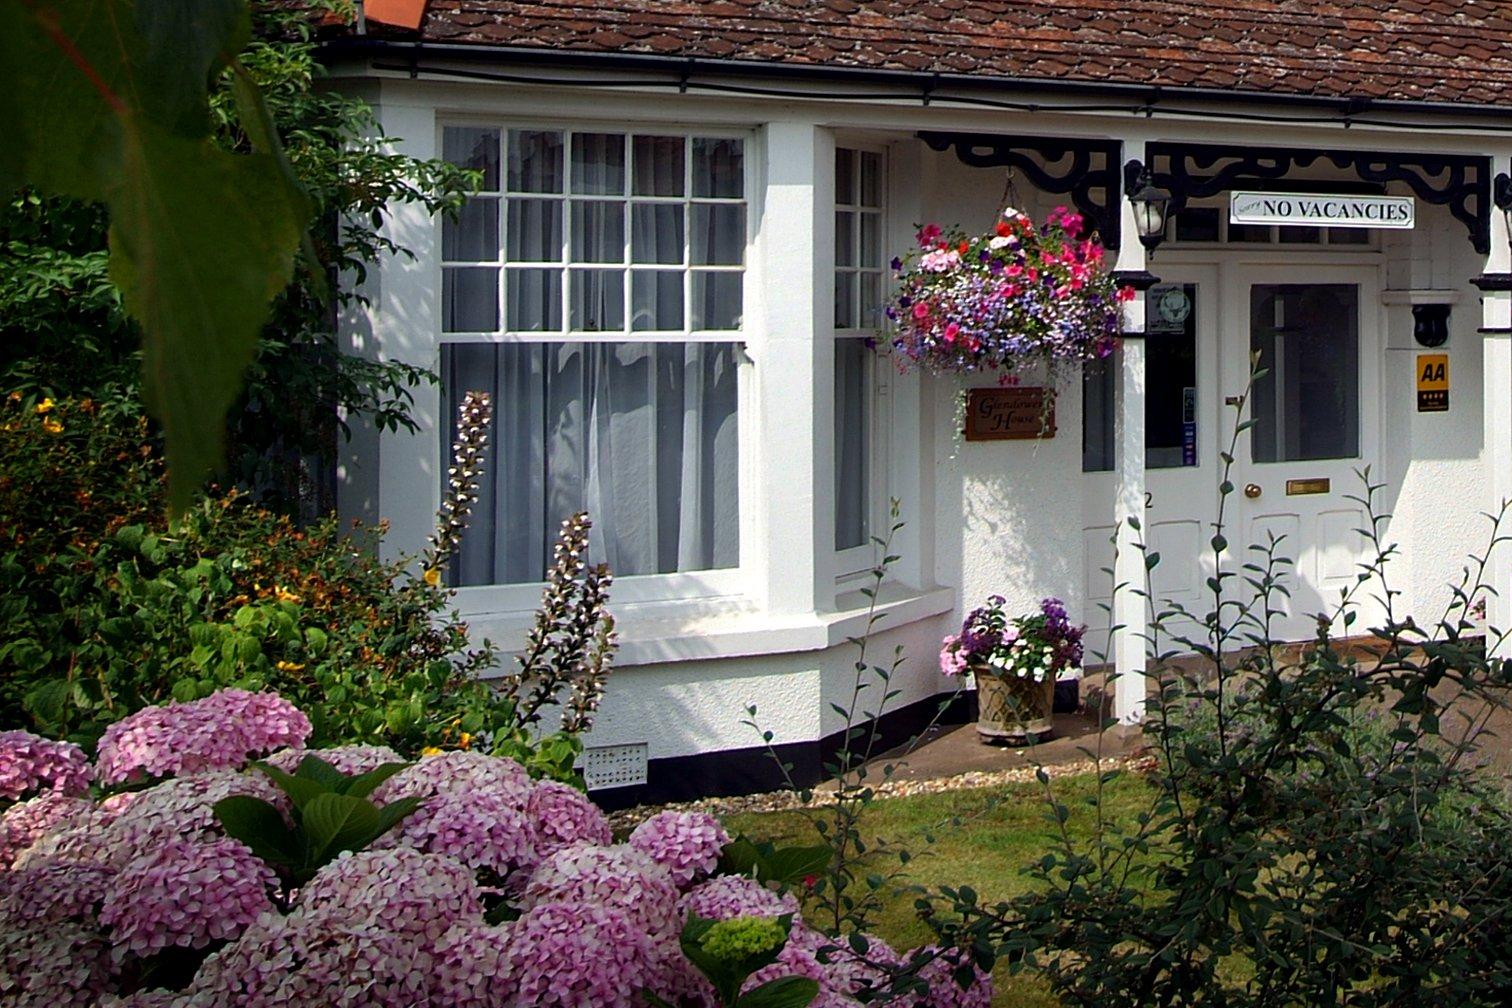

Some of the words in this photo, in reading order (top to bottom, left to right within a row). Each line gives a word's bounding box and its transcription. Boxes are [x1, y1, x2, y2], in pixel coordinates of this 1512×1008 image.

[1263, 200, 1292, 217] NO
[1298, 201, 1408, 220] VACANCIES
[1421, 363, 1445, 382] AA
